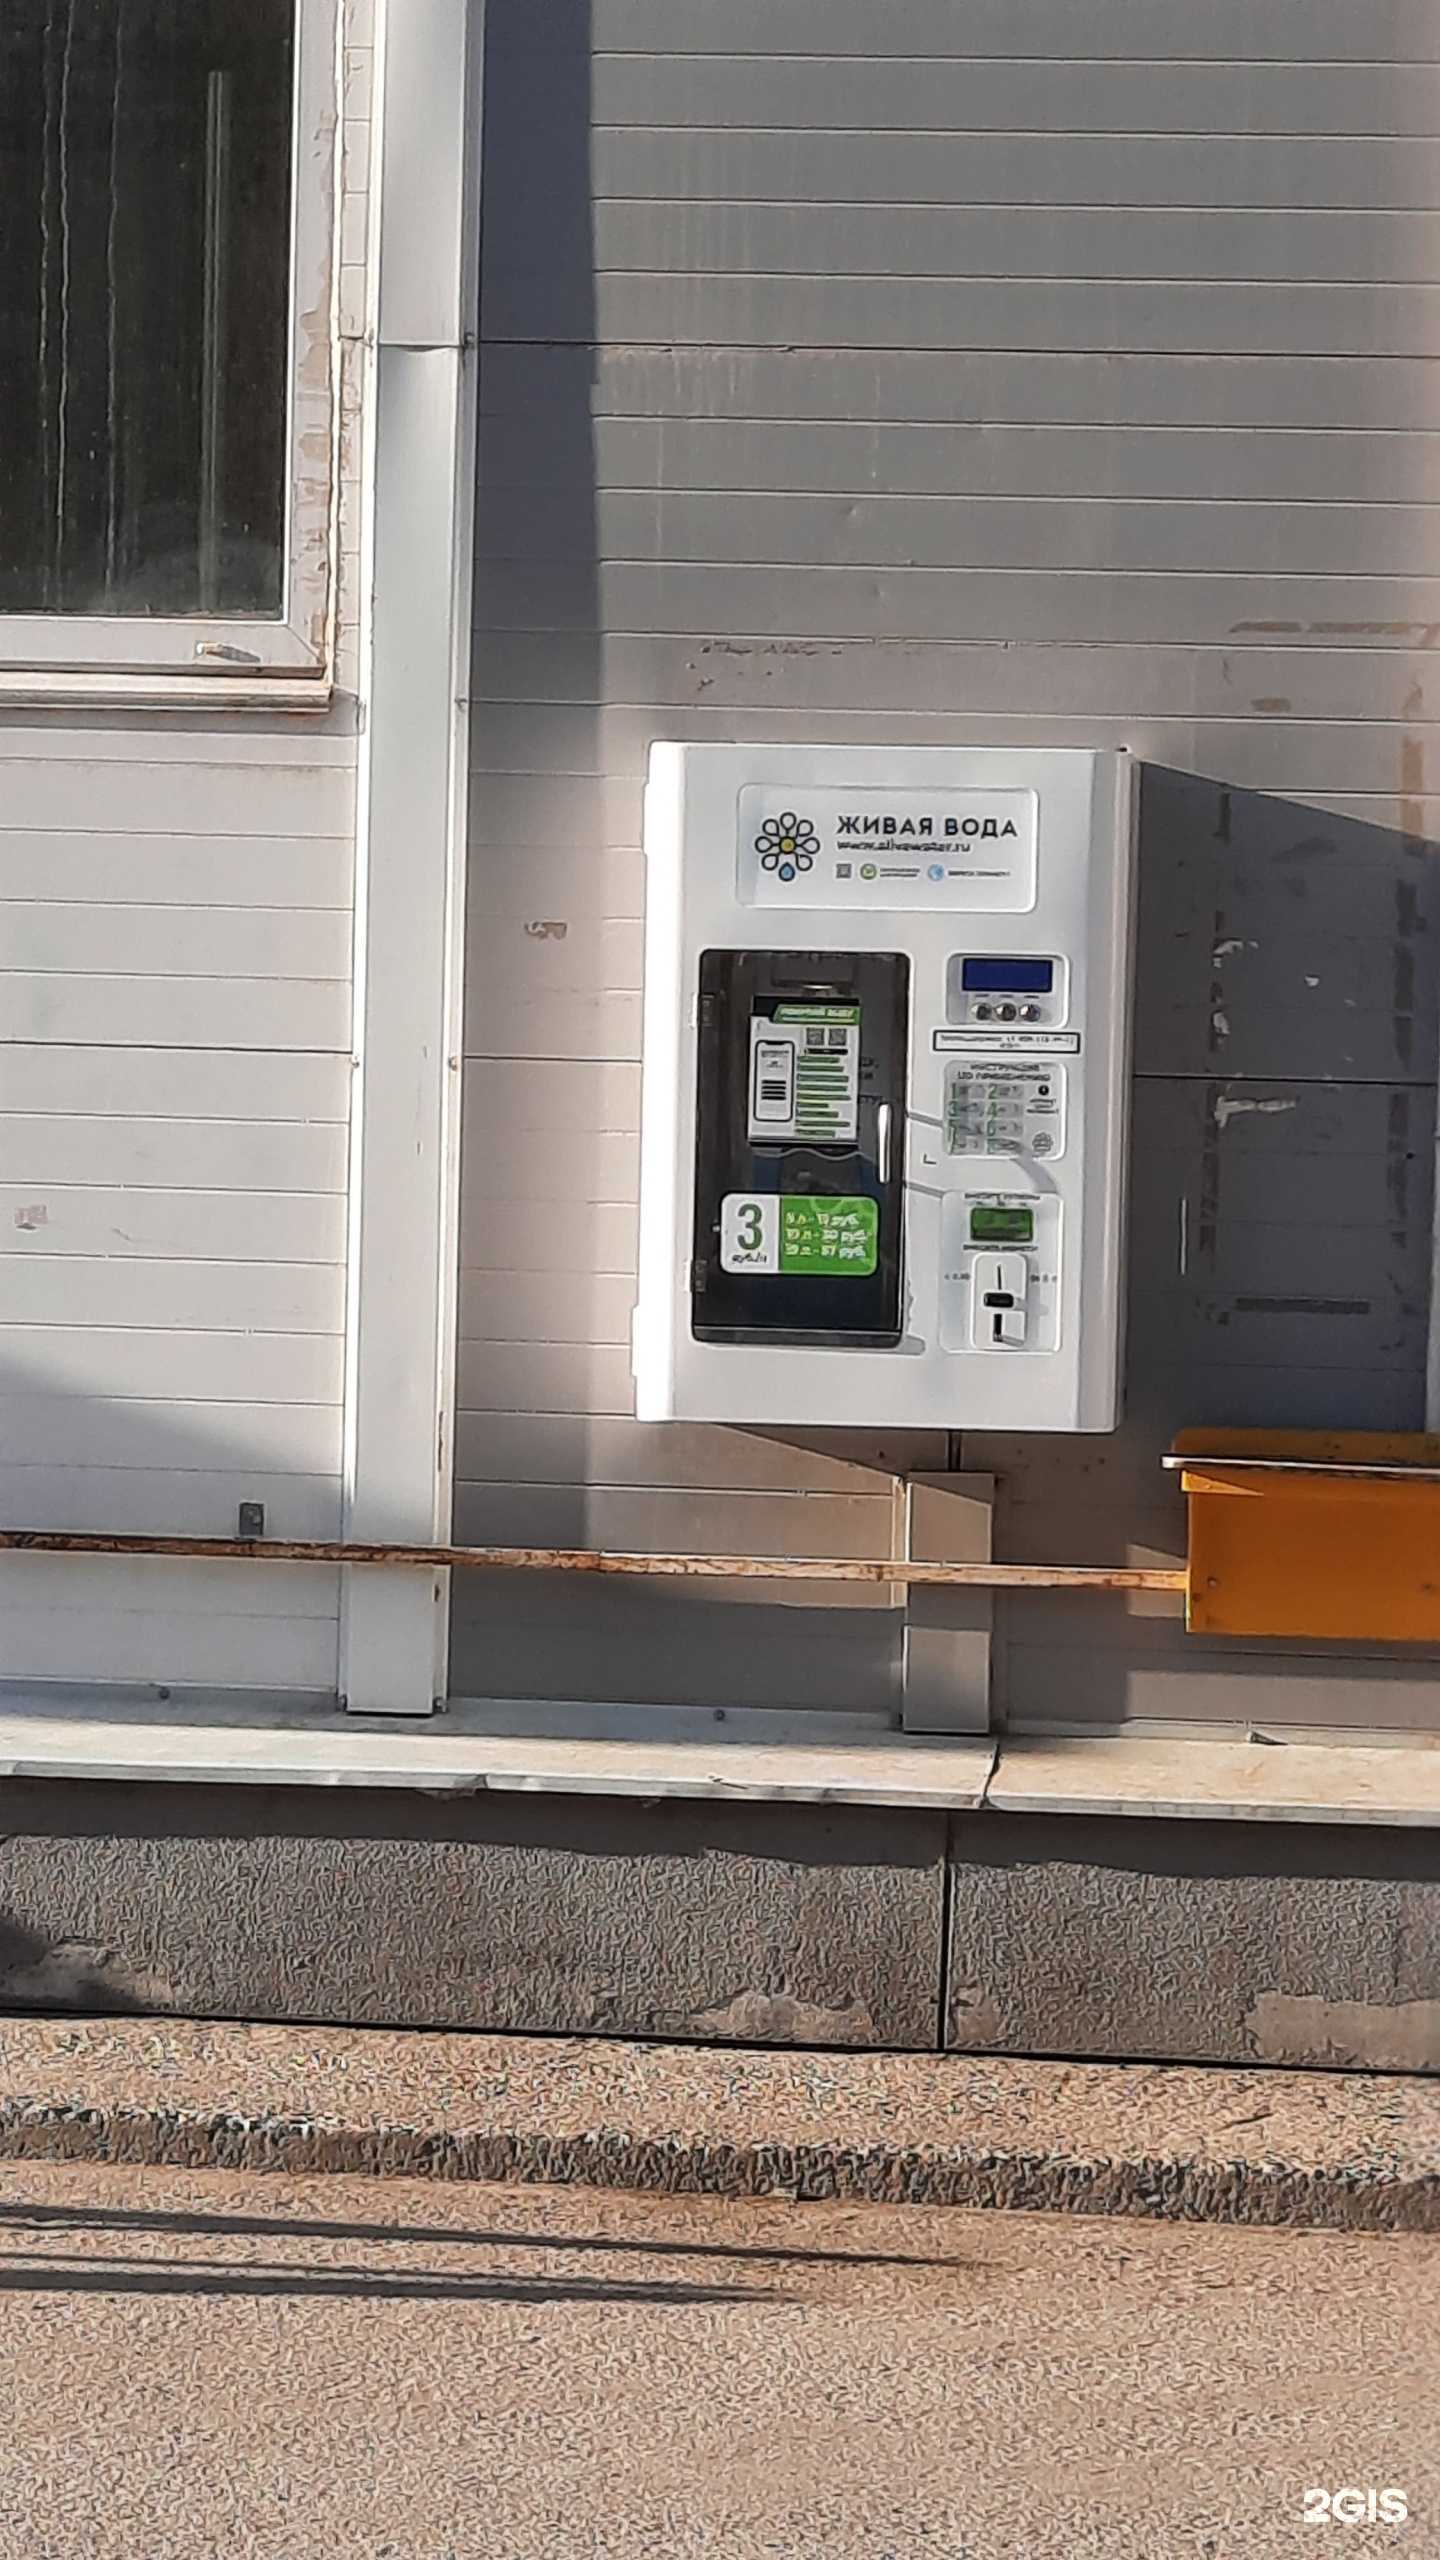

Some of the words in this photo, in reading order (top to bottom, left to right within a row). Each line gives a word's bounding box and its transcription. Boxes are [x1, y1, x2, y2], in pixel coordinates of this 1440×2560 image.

[836, 815, 933, 835] ЖИВАЯ
[944, 817, 1018, 838] ВОДА
[737, 1203, 763, 1250] 3
